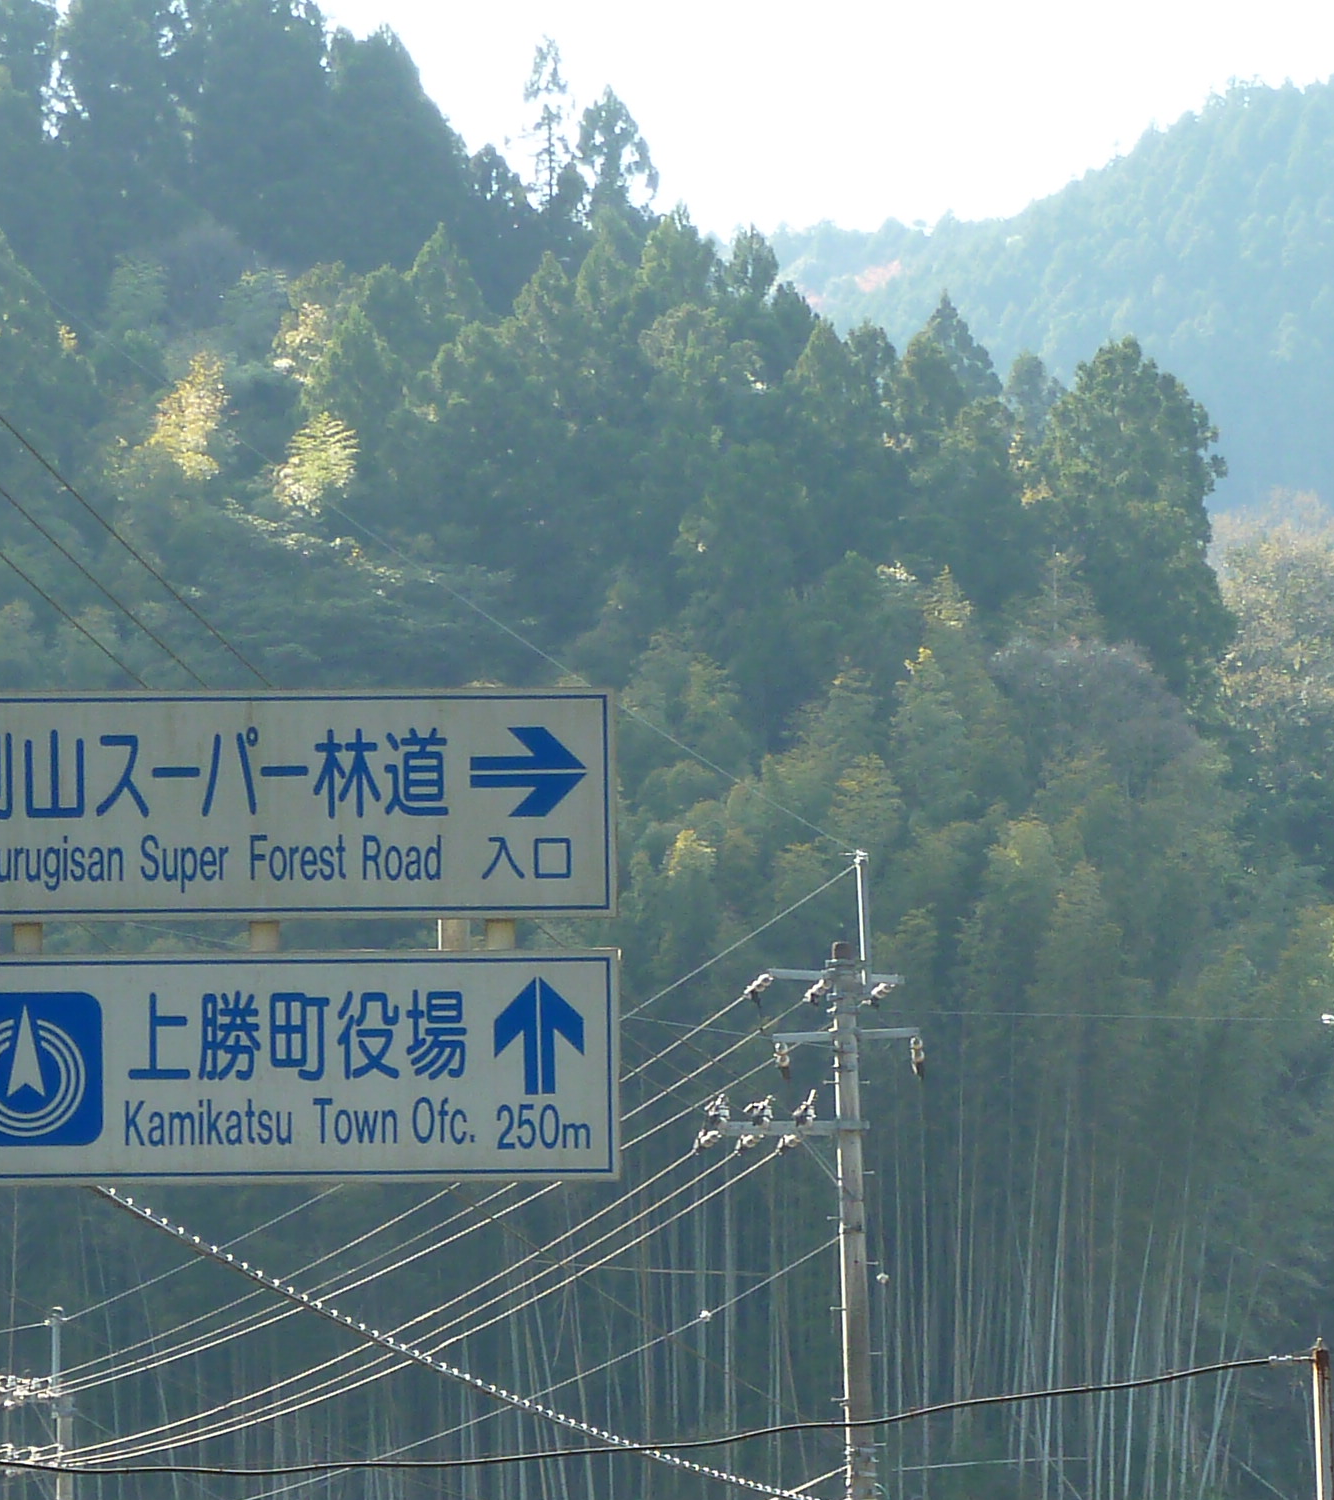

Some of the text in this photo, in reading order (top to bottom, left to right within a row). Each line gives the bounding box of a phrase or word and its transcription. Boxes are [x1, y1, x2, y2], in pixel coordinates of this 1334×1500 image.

[139, 834, 229, 893] Super
[249, 834, 347, 882] Forest
[364, 834, 442, 882] Road
[481, 836, 573, 881] 入口
[127, 989, 467, 1082] 上勝町役場
[124, 1096, 476, 1149] Kamikatsu Town Ofc.
[496, 1104, 592, 1151] 250m
